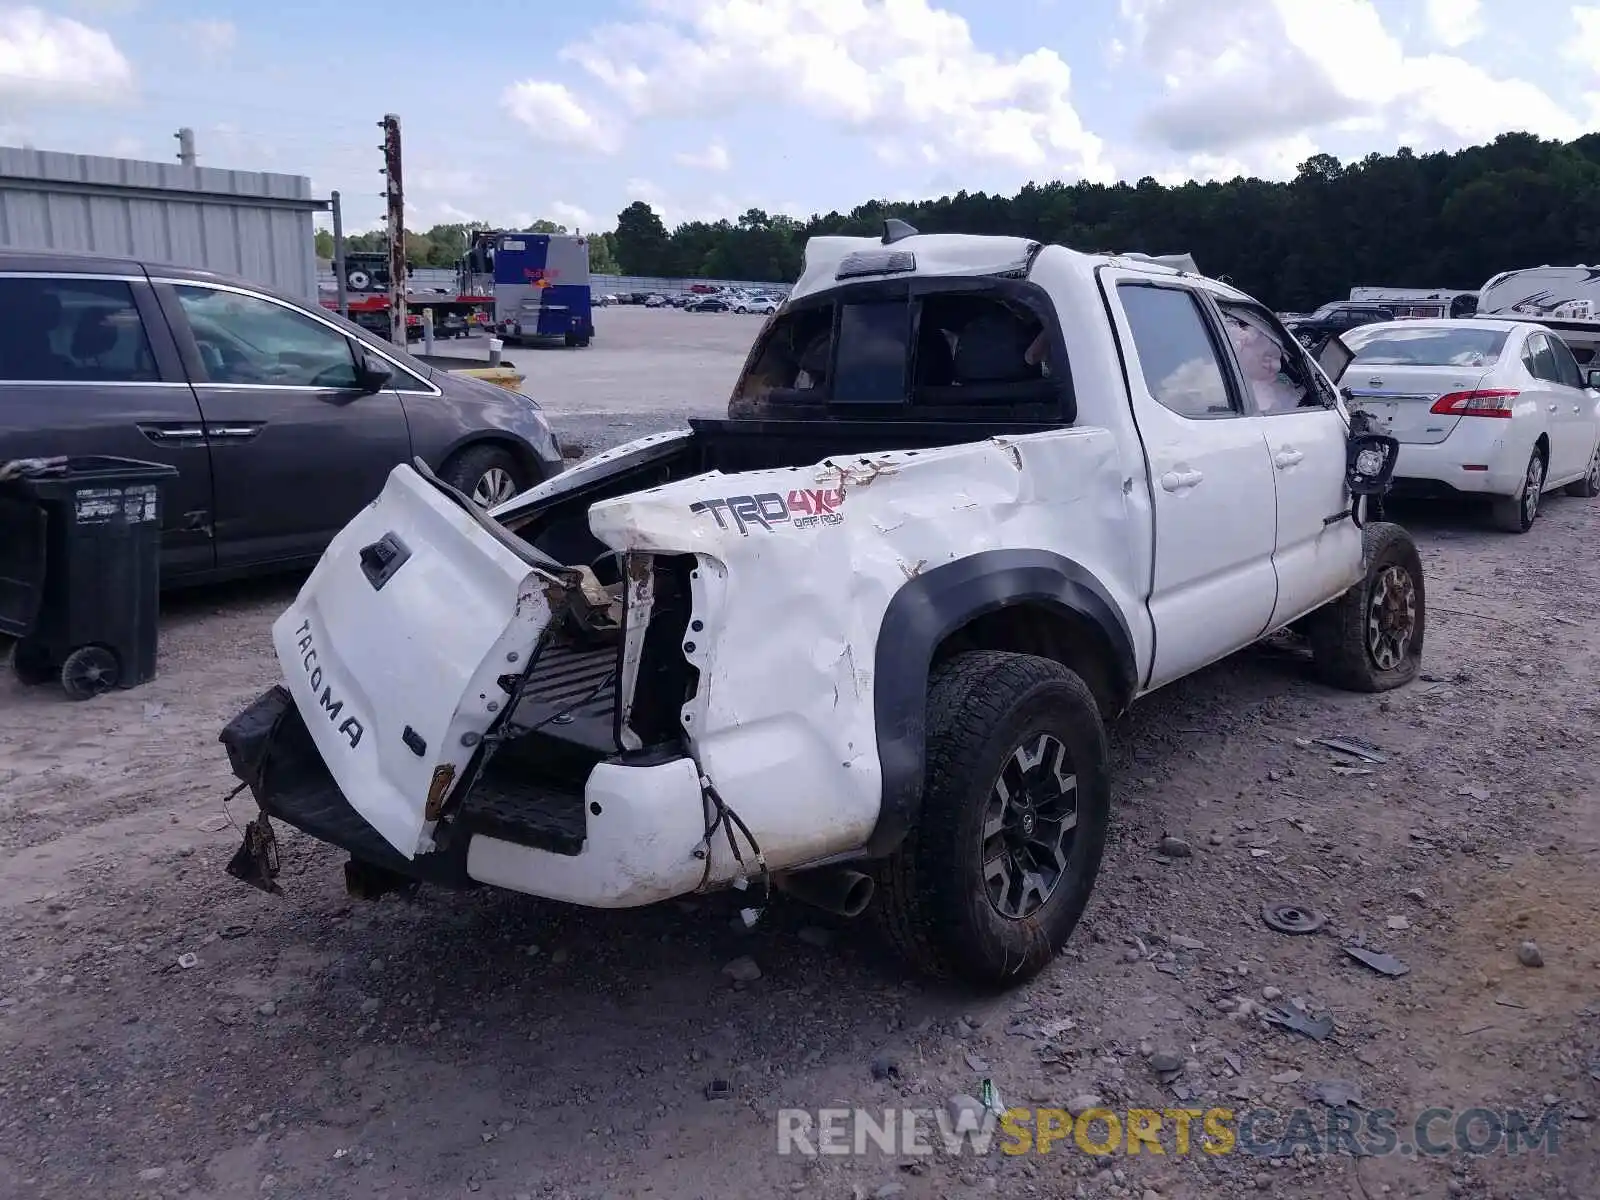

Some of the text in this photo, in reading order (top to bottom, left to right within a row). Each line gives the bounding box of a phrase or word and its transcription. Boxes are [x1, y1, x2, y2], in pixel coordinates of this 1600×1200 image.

[689, 493, 791, 536] TRD
[793, 515, 819, 529] OFF
[296, 619, 364, 749] TACOMA
